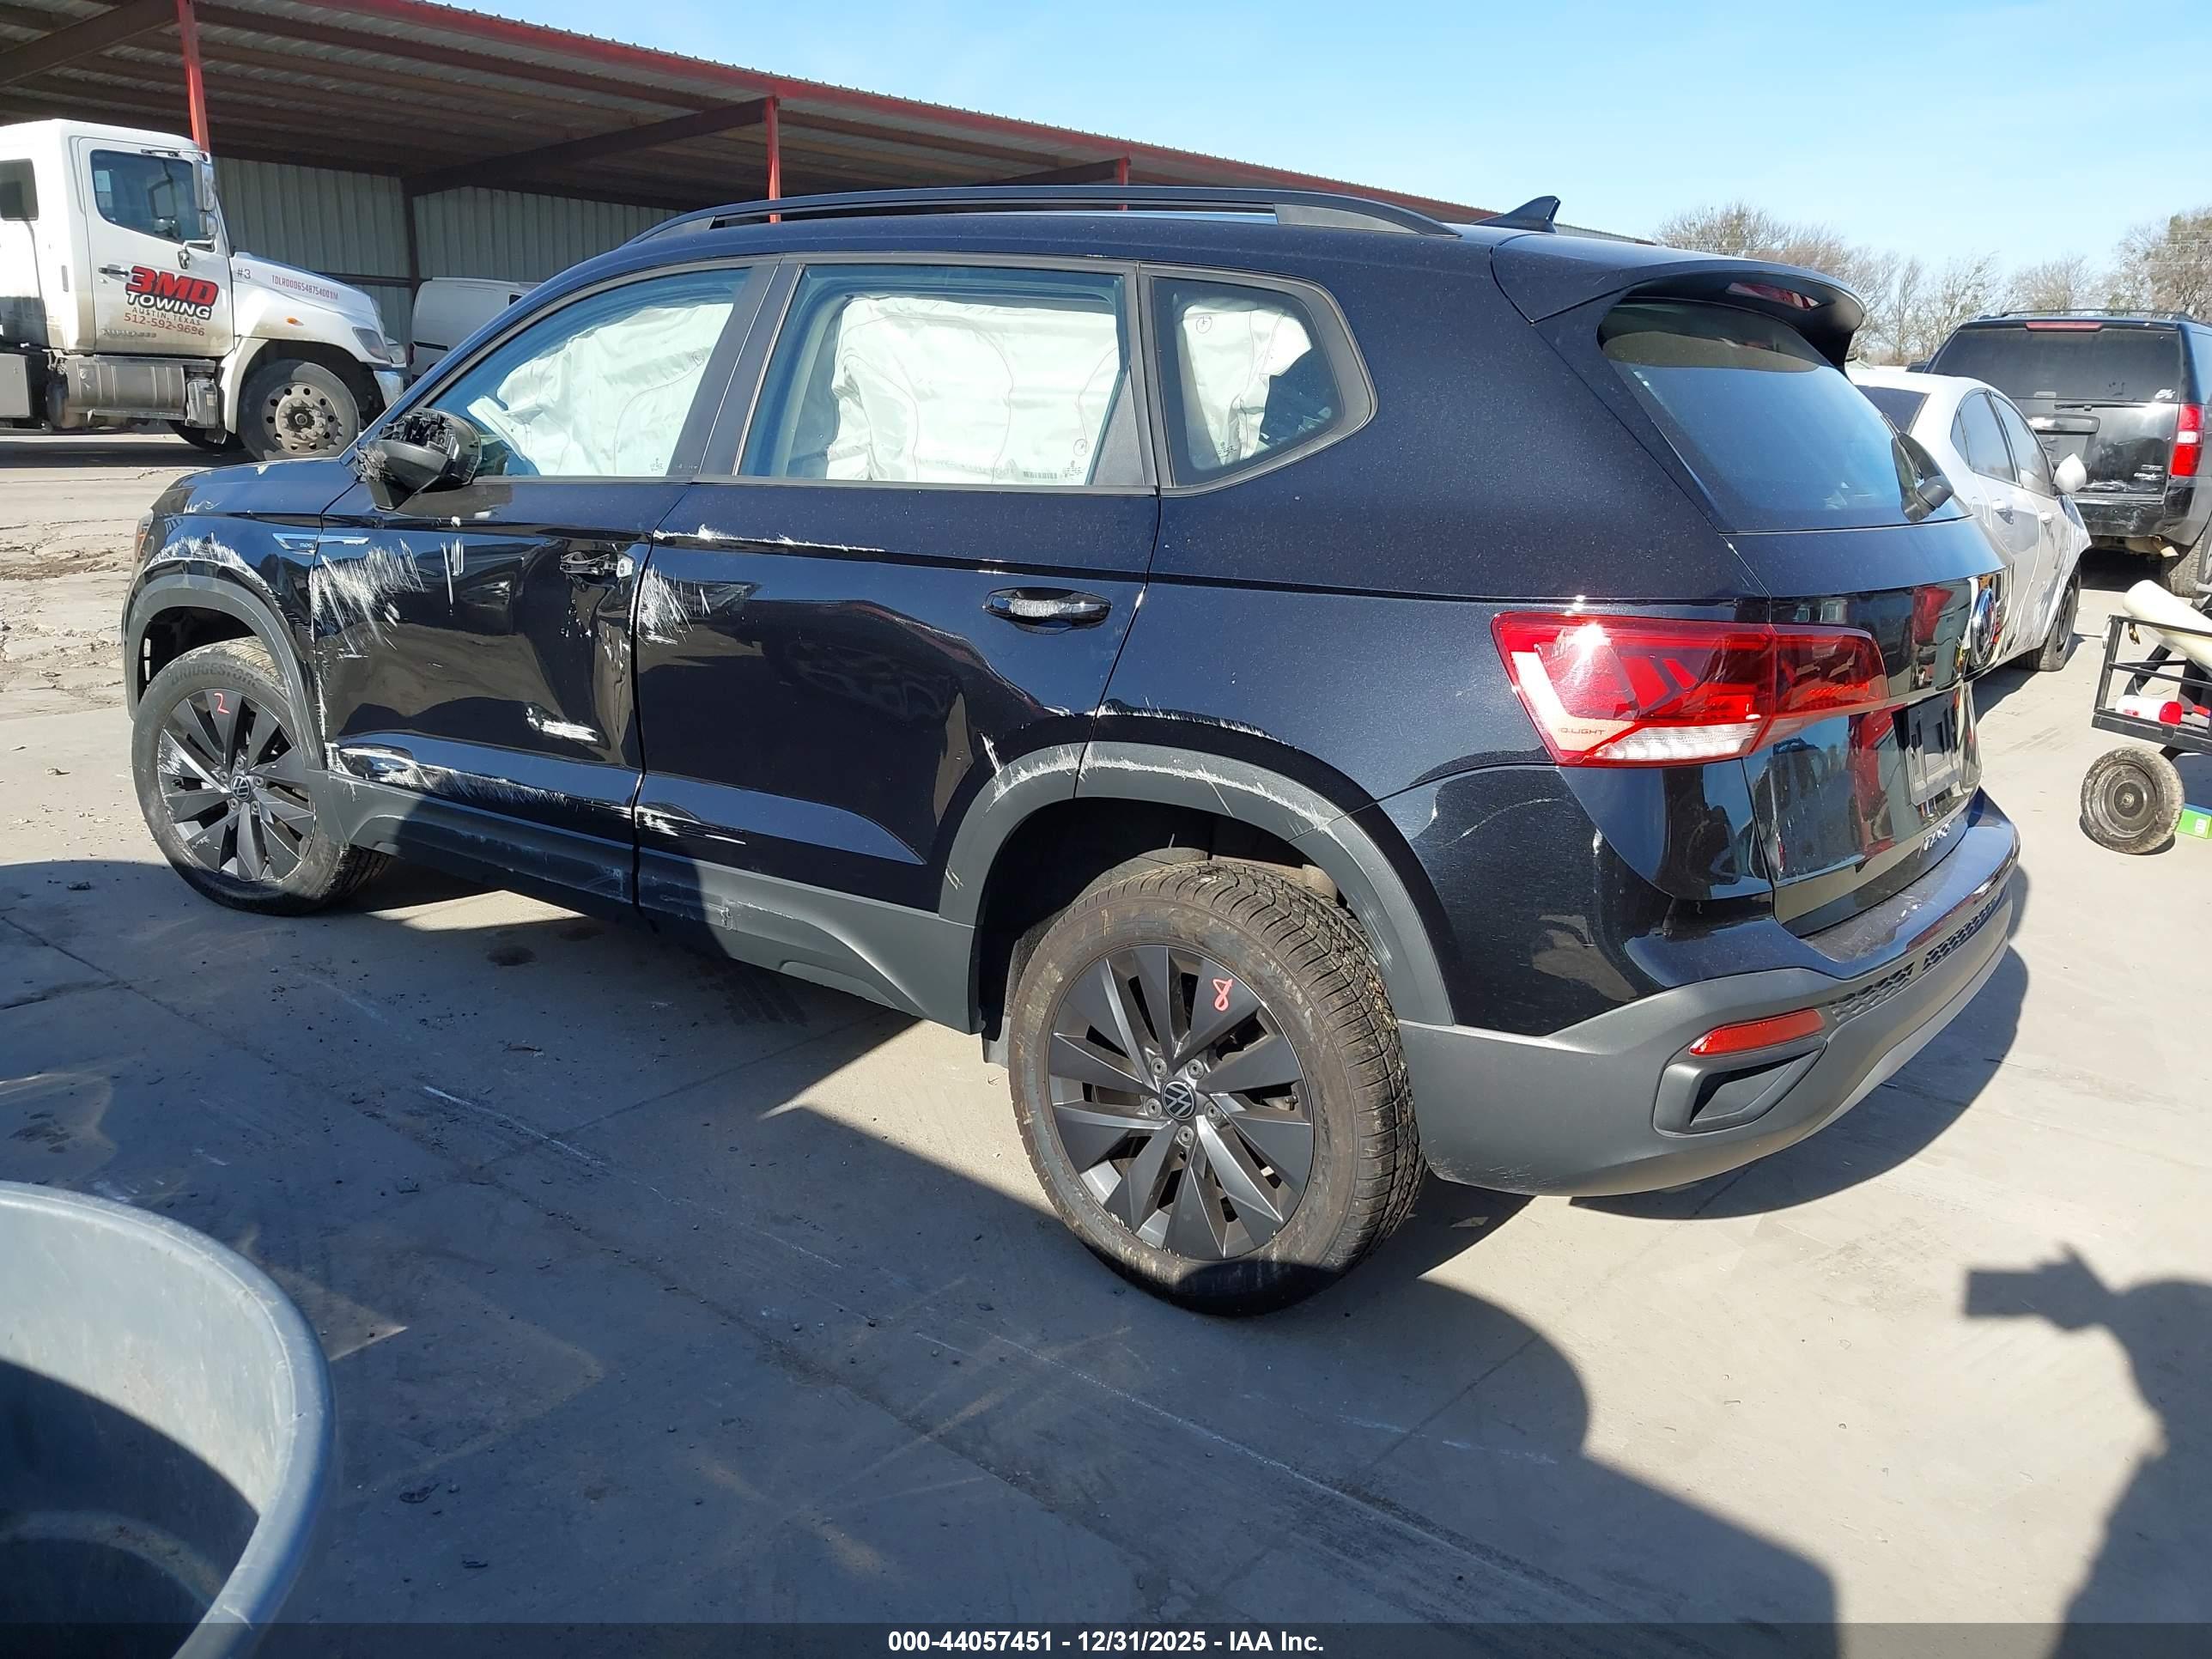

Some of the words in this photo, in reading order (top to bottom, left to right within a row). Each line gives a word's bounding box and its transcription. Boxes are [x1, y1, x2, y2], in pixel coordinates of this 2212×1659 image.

[125, 265, 219, 307] 3MD
[237, 268, 252, 279] #3
[126, 291, 212, 320] TOWING
[131, 307, 170, 320] AUSTIN,
[173, 314, 202, 326] TEXAS
[214, 692, 230, 714] 2
[1212, 978, 1233, 1012] 8
